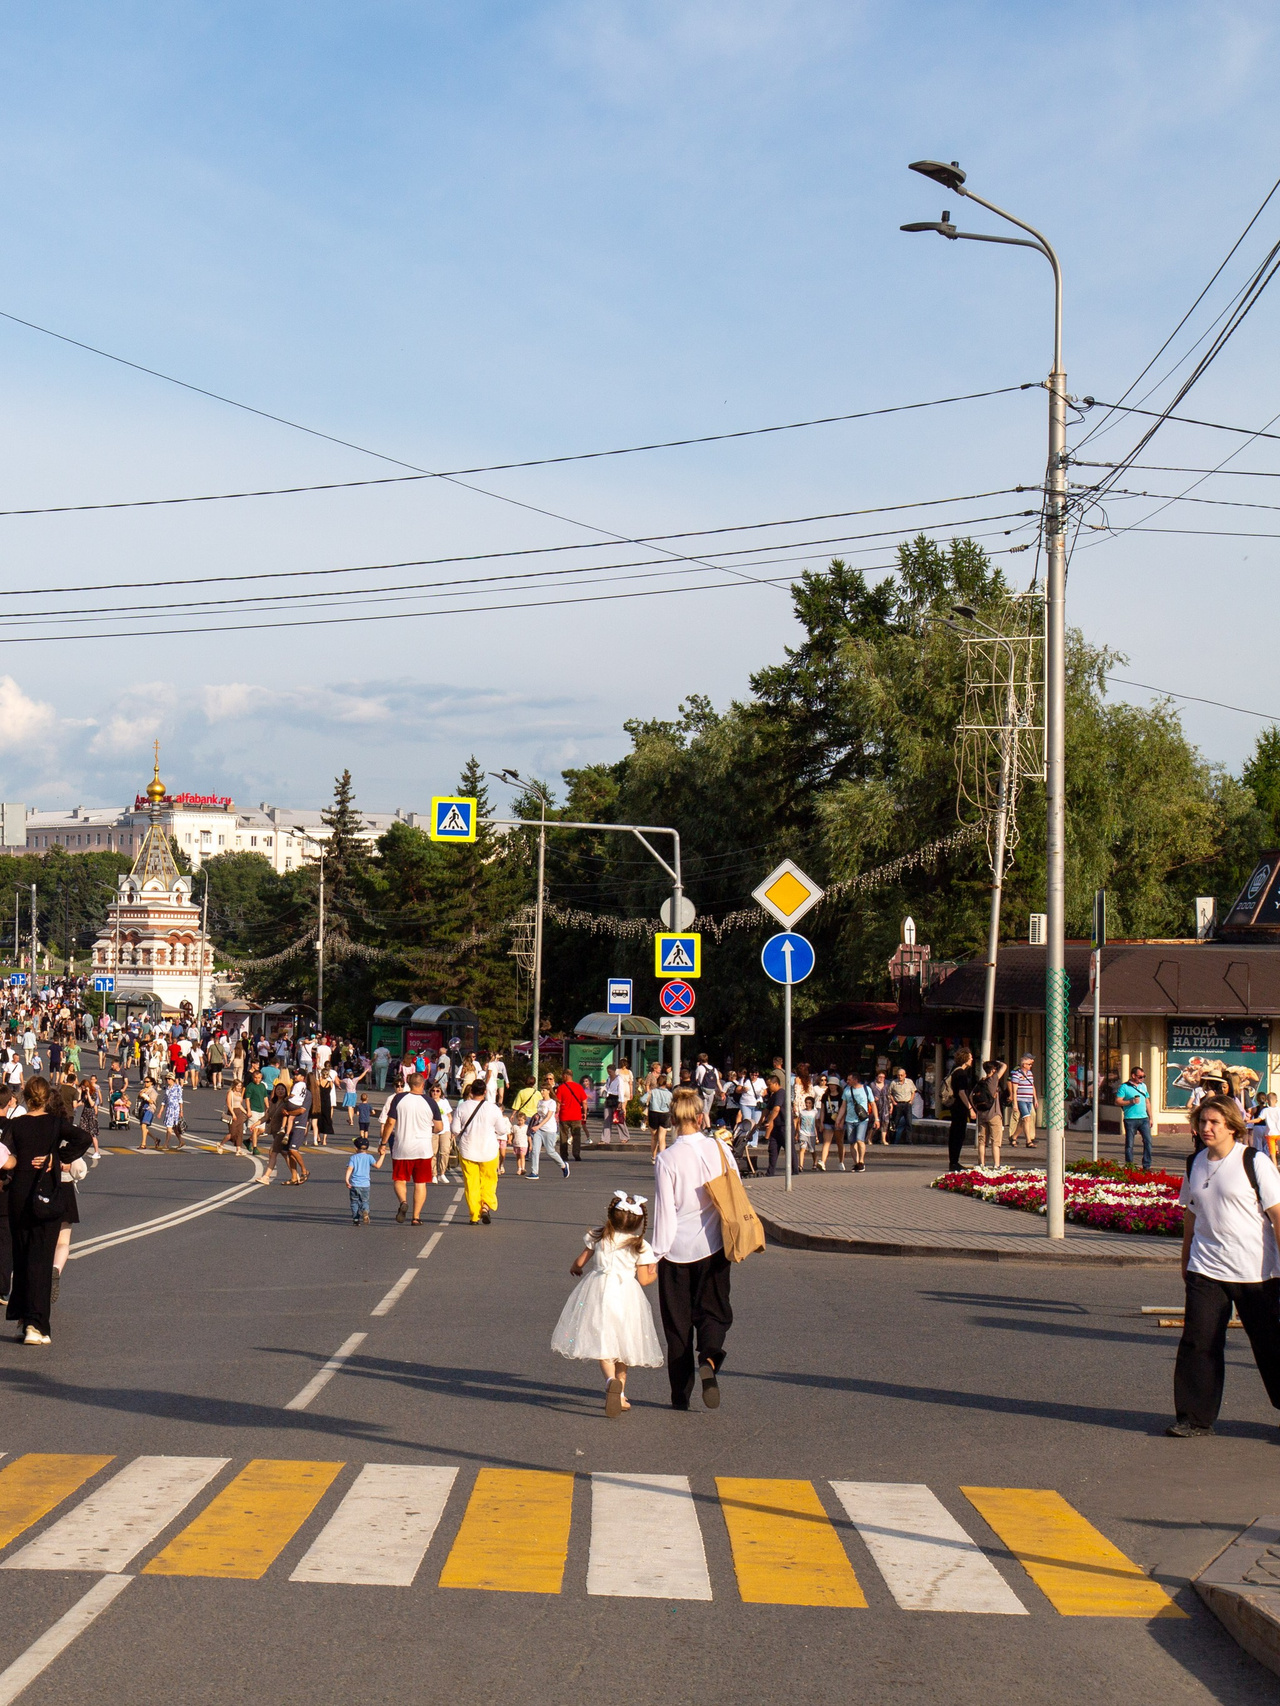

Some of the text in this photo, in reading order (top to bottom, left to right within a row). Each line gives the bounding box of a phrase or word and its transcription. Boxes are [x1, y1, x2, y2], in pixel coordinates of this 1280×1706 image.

[176, 792, 232, 805] alfabank.ru
[1173, 1026, 1218, 1037] БЛЮДА
[1173, 1037, 1191, 1047] НА
[1193, 1038, 1231, 1047] ГРИЛЕ
